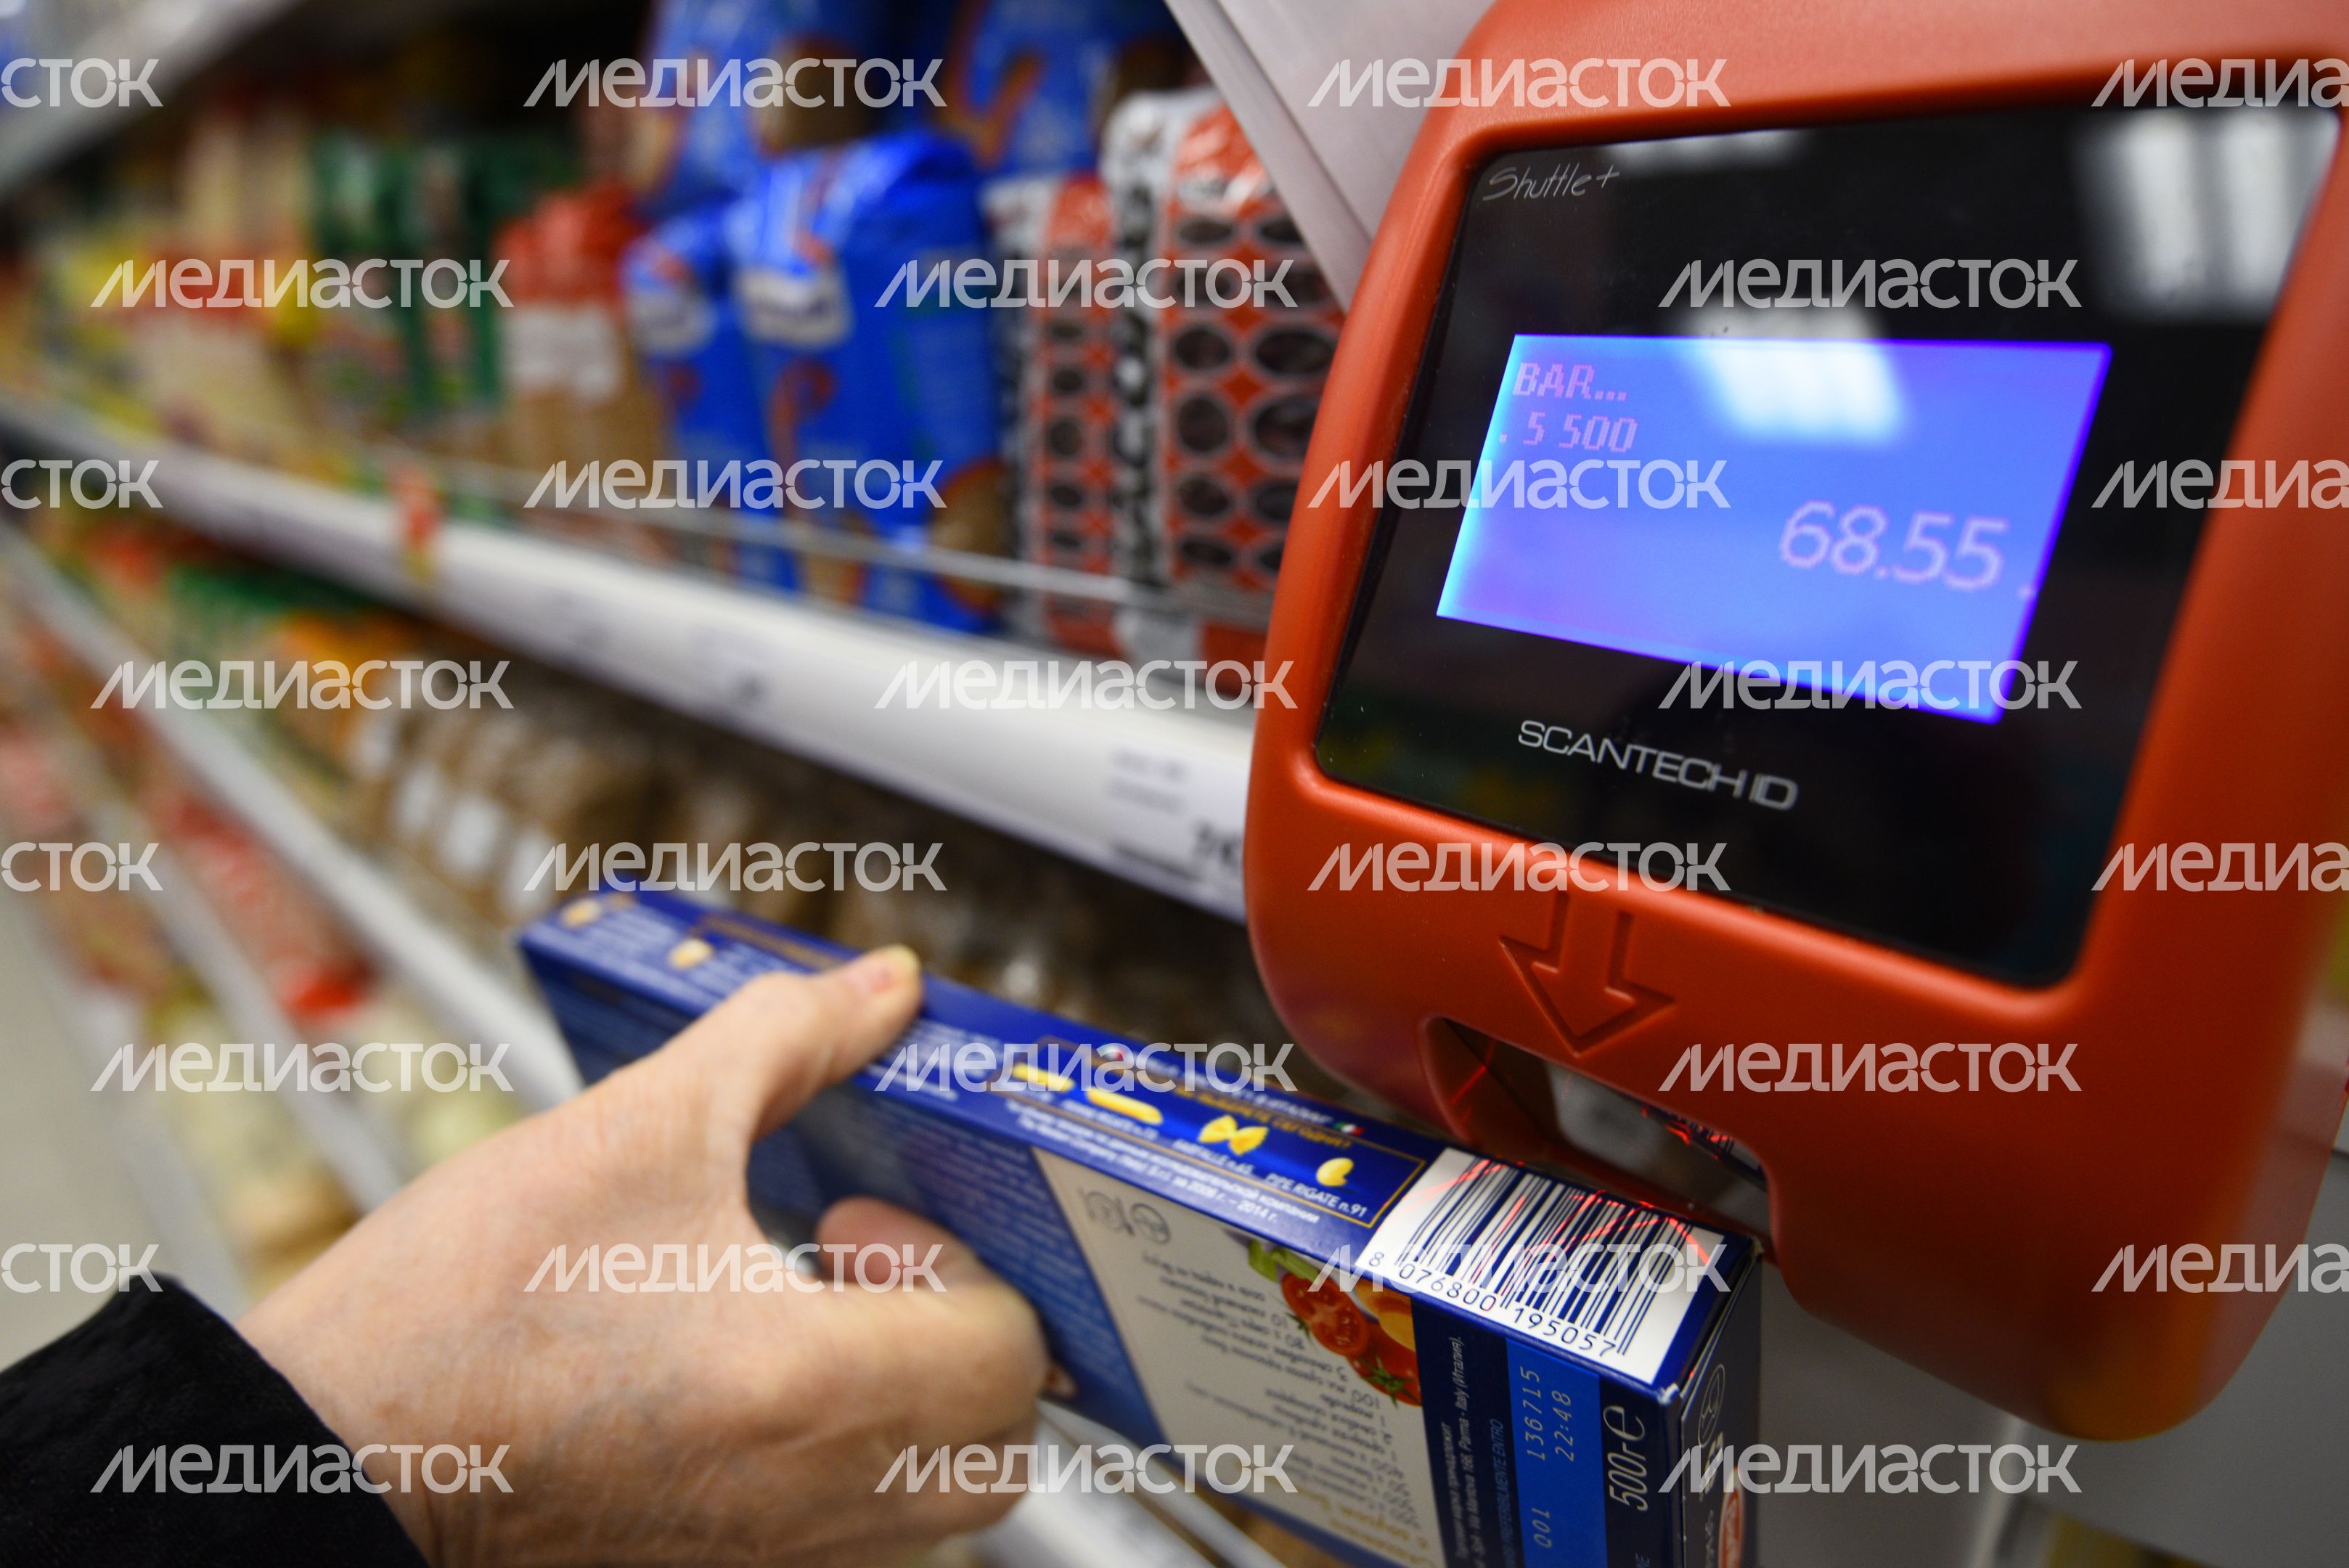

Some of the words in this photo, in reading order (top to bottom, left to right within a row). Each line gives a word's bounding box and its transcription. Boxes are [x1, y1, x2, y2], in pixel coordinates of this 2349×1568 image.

[1523, 411, 1546, 446] 5
[1558, 413, 1638, 453] 500
[1779, 499, 2011, 592] 68.55
[1518, 719, 1748, 799] SCANTECH
[1748, 773, 1799, 812] ID
[1236, 1199, 1270, 1219] 2014
[1292, 1183, 1341, 1208] RIGATE
[1338, 1202, 1368, 1218] n.91
[1368, 1251, 1385, 1267] 8
[1398, 1263, 1498, 1312] 076800
[1514, 1307, 1617, 1357] 195057
[1520, 1365, 1545, 1461] 136715
[1552, 1390, 1574, 1463] 22:48
